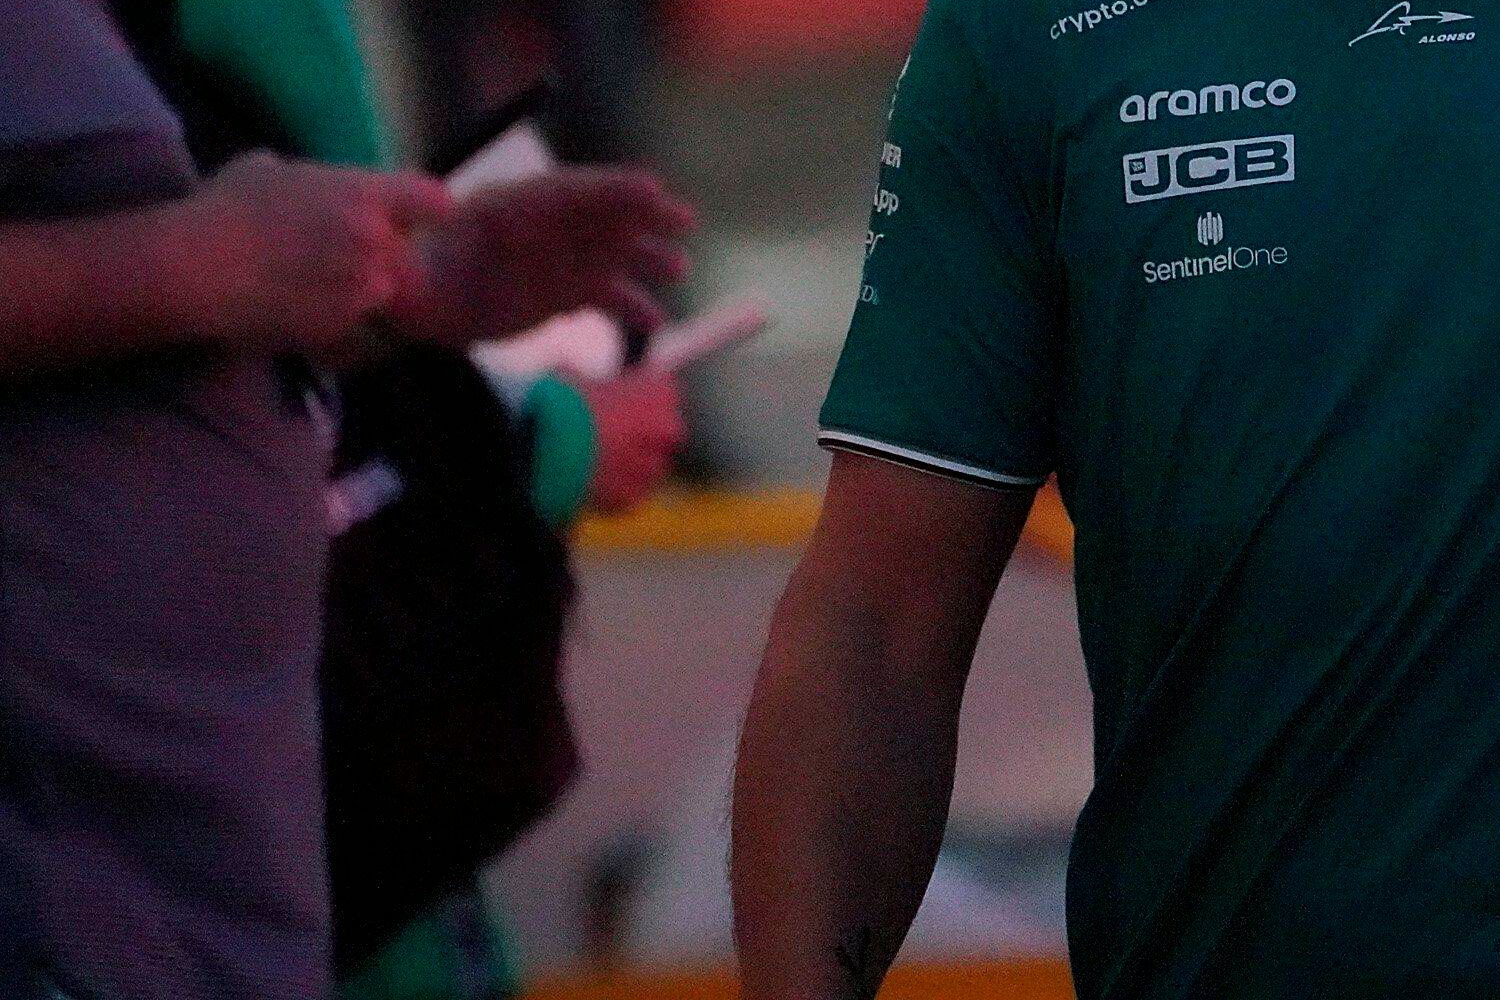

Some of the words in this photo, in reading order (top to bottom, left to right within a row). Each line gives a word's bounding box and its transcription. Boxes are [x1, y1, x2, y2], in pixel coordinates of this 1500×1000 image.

[1418, 31, 1476, 44] ALONSO
[1119, 78, 1297, 123] aramco
[1129, 140, 1290, 198] JCB
[1142, 246, 1288, 284] SentinelOne
